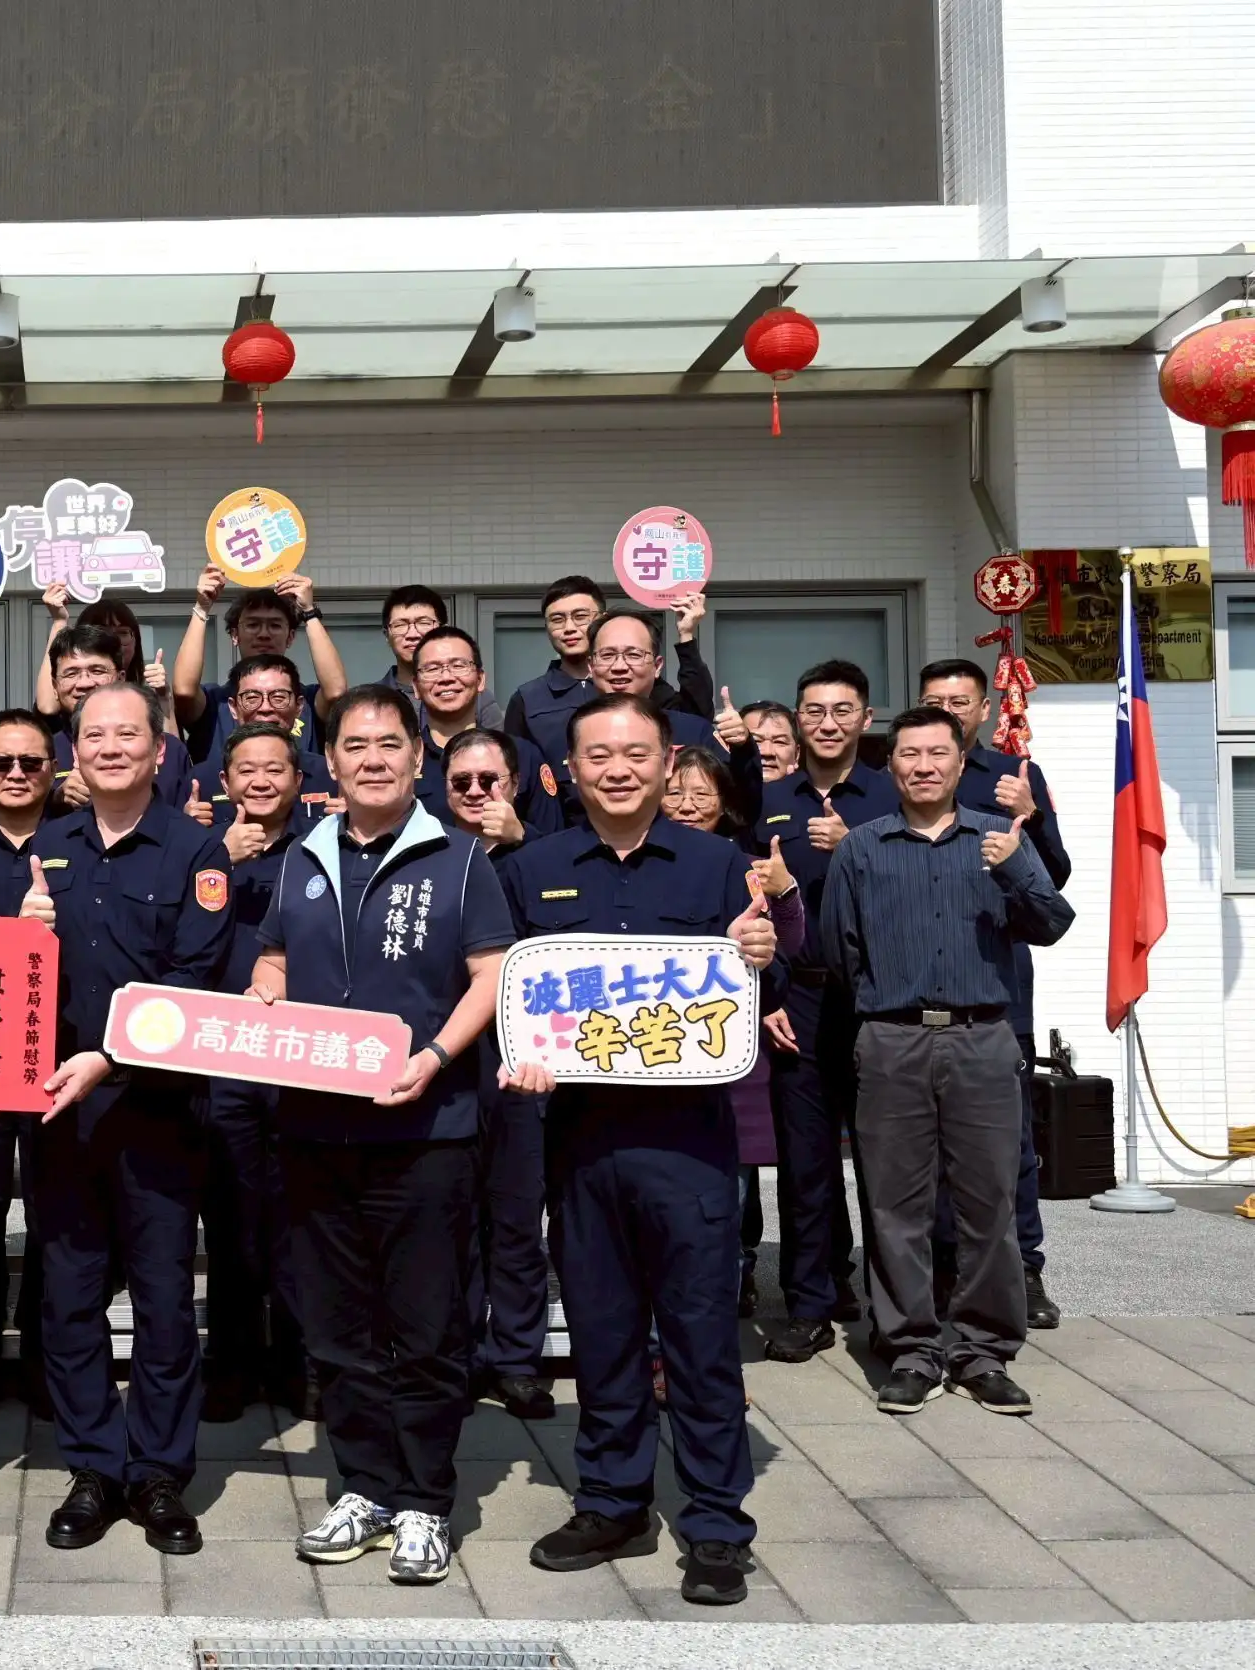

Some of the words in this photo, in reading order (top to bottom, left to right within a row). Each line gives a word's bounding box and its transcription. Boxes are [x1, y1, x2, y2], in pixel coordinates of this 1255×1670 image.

[56, 516, 117, 535] 更美好
[66, 495, 106, 514] 世界
[996, 573, 1016, 595] 春
[382, 883, 413, 961] 劉德林
[413, 878, 433, 951] 高雄市議員
[522, 954, 743, 1016] 波麗士大人
[24, 952, 43, 1085] 警察局春節慰勞
[192, 1015, 391, 1074] 高雄市議會
[575, 998, 739, 1072] 辛苦了
